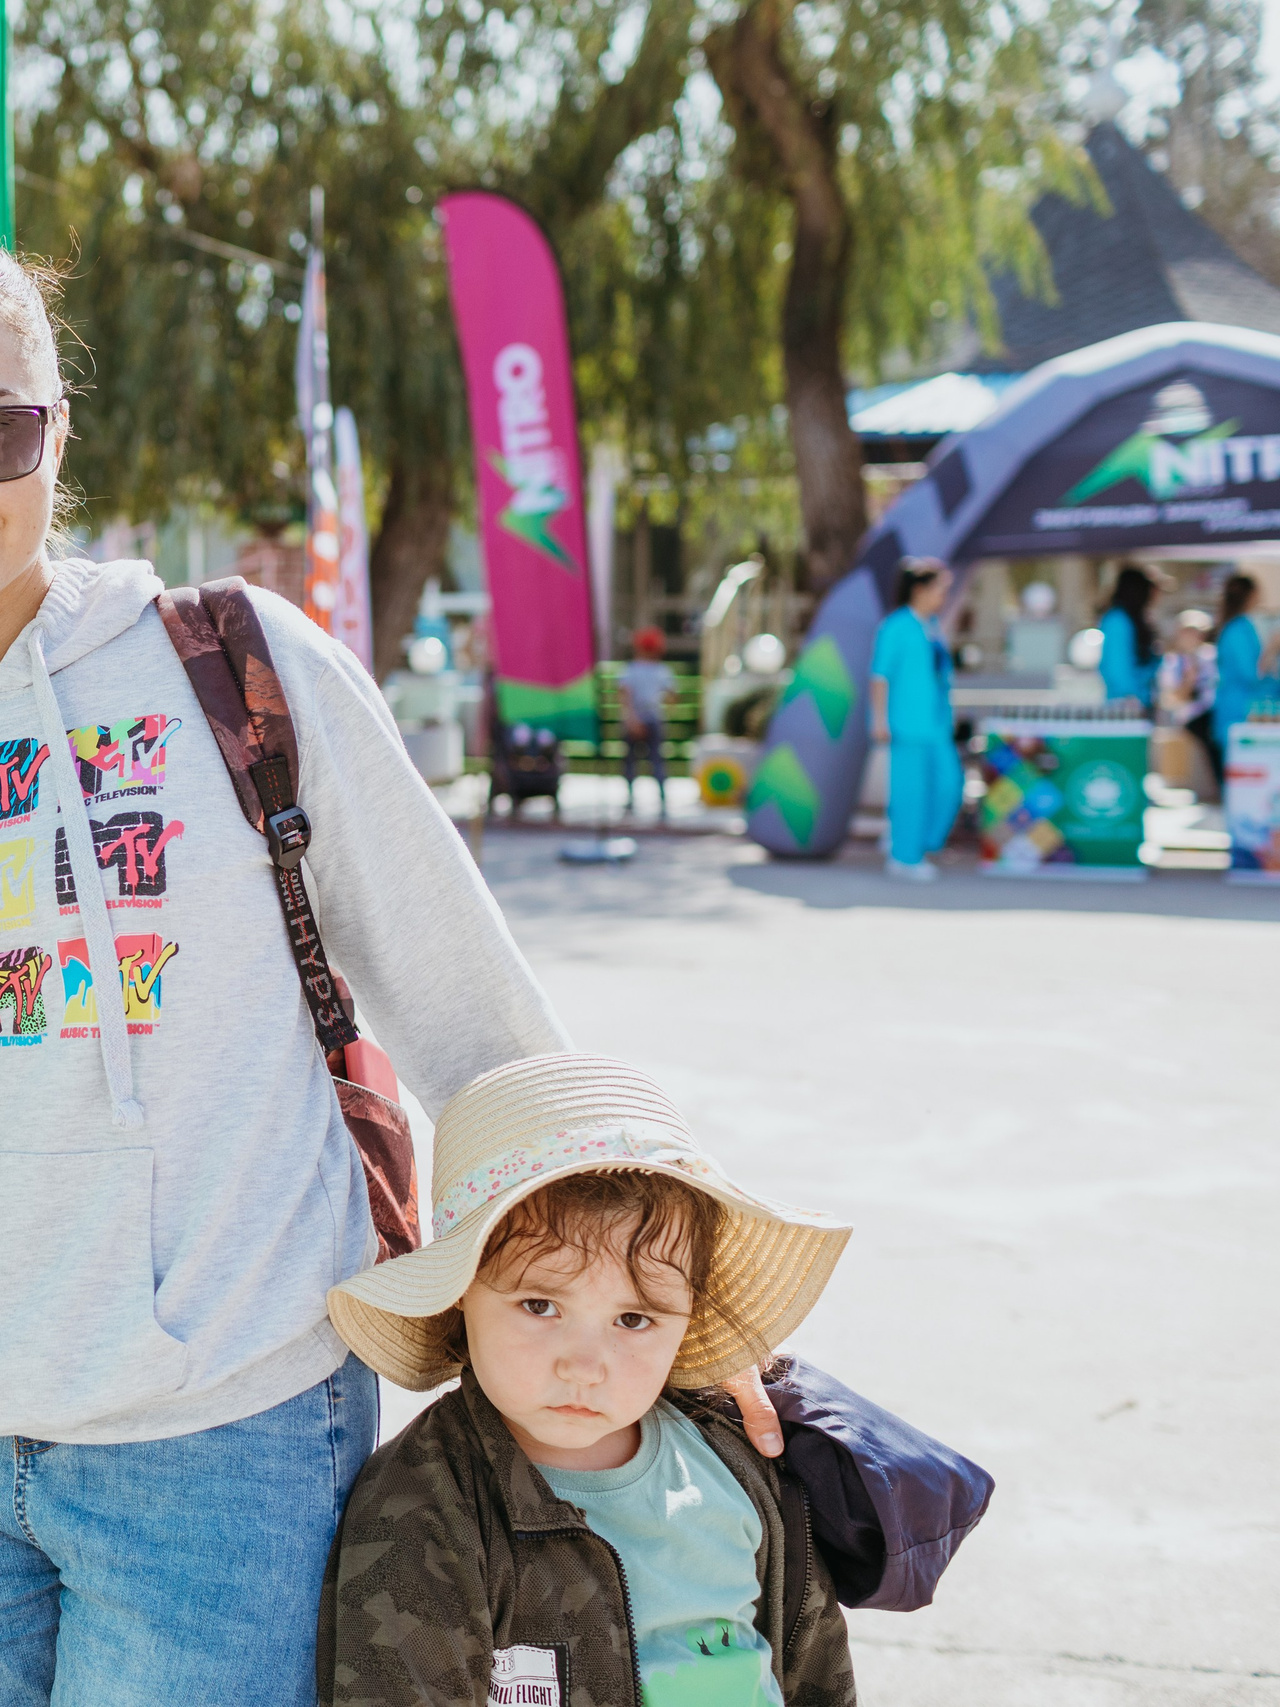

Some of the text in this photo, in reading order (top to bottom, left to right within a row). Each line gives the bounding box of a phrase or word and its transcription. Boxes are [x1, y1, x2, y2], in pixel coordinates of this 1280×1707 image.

[105, 898, 163, 909] ELEVISION
[60, 1027, 89, 1038] MUSIC
[488, 1680, 552, 1707] HRILL FLIGHT
